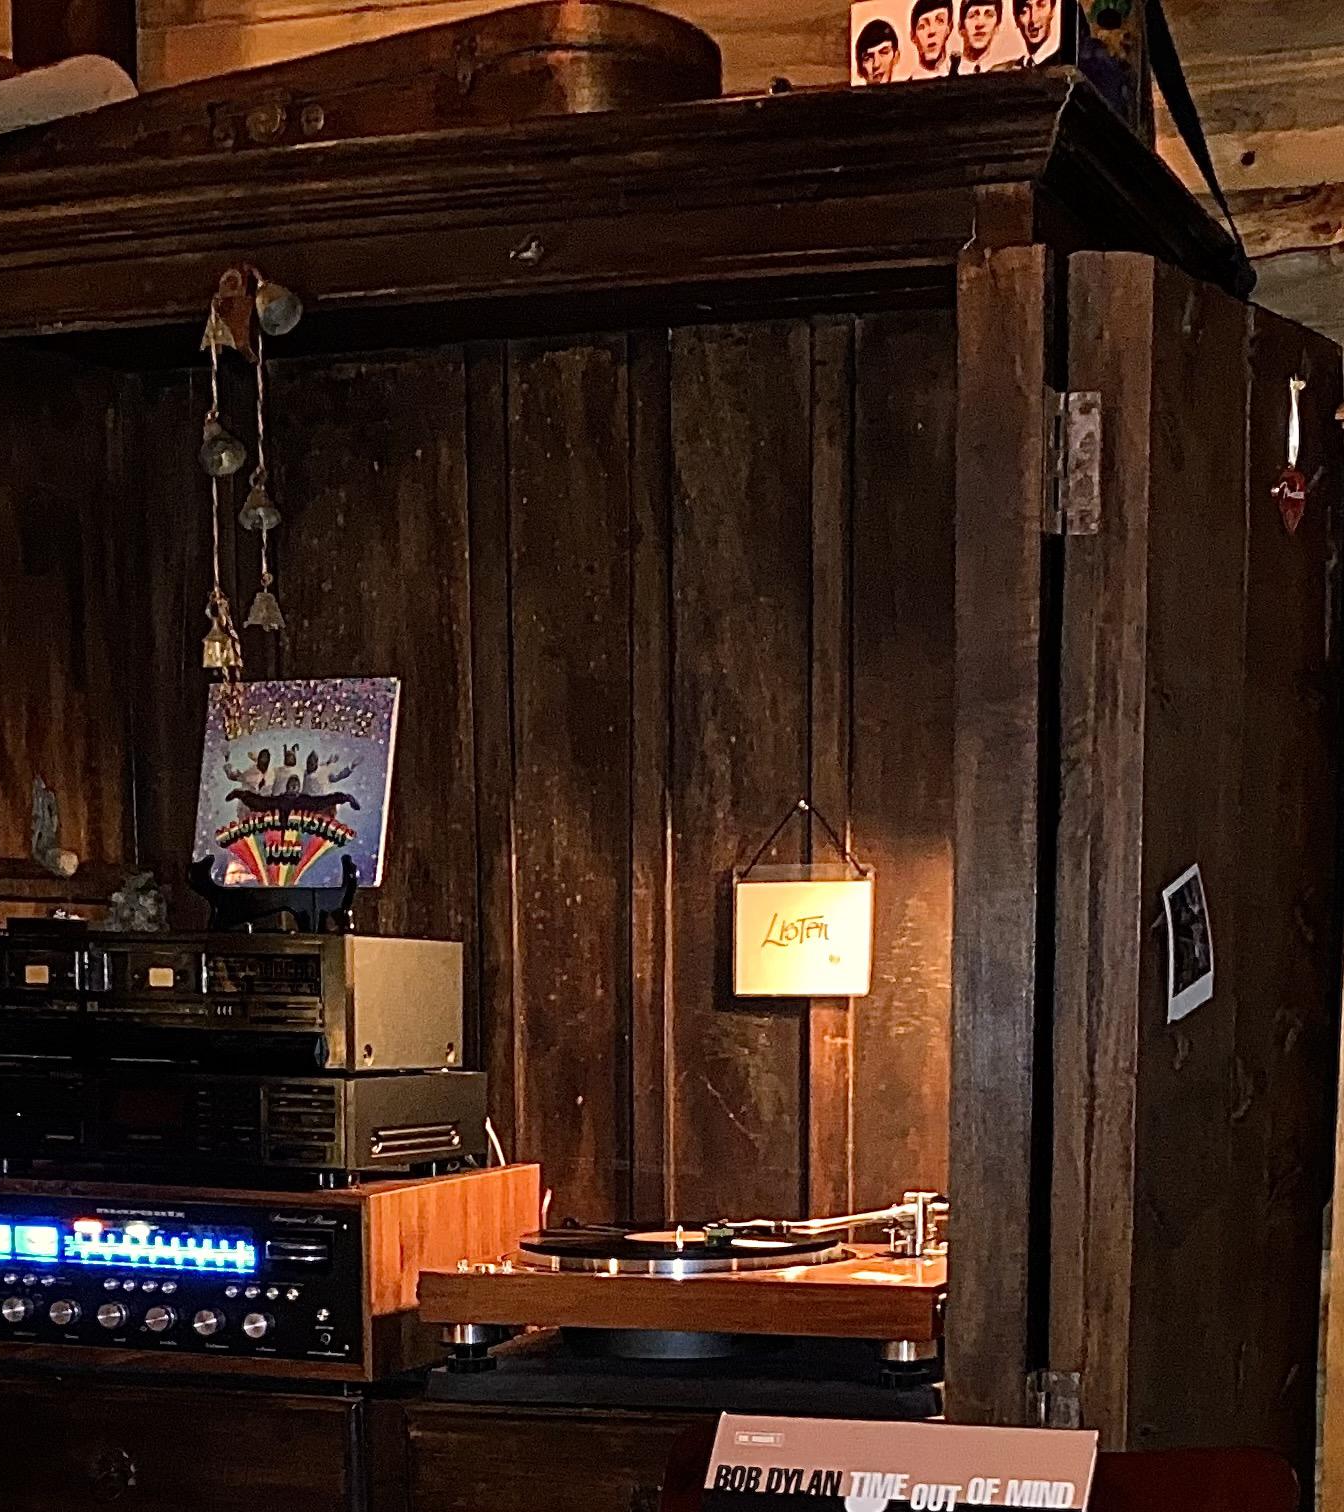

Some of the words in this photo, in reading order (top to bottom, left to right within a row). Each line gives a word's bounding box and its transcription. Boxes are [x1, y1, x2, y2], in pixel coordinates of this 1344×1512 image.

[713, 1464, 763, 1493] BOB
[764, 1467, 843, 1498] DYLAN
[849, 1471, 910, 1501] TIME
[910, 1482, 963, 1512] OUT
[966, 1477, 1001, 1505] OF
[1005, 1478, 1076, 1509] MIND
